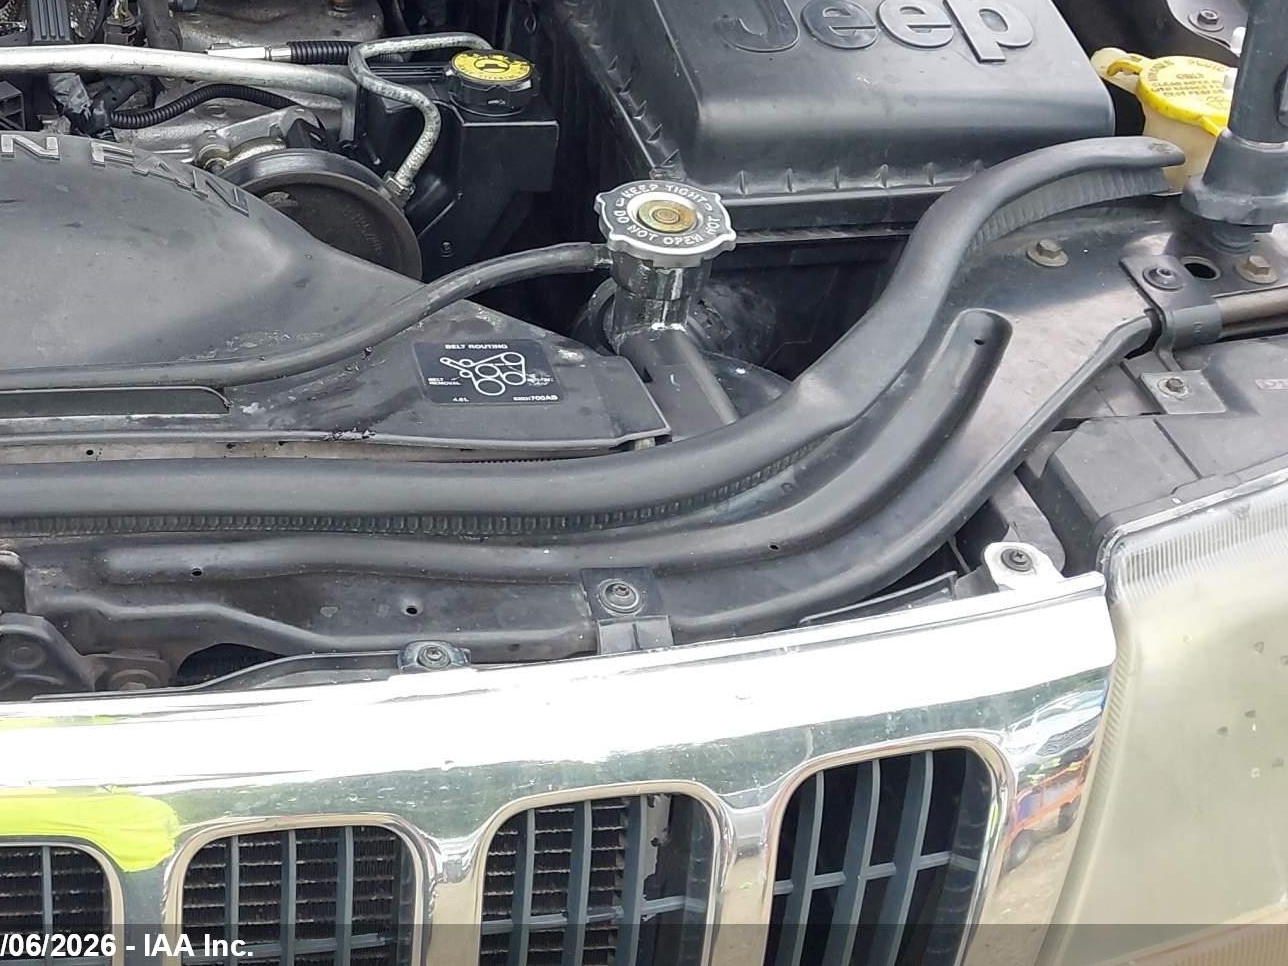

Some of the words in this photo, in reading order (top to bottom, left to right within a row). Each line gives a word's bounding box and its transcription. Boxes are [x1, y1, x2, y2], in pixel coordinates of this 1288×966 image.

[90, 140, 250, 218] FAN
[621, 183, 659, 201] KEEP
[665, 184, 708, 204] TIGHT
[612, 209, 631, 224] DO
[626, 224, 659, 242] NOT
[663, 233, 705, 246] OPEN
[705, 215, 722, 235] HOT
